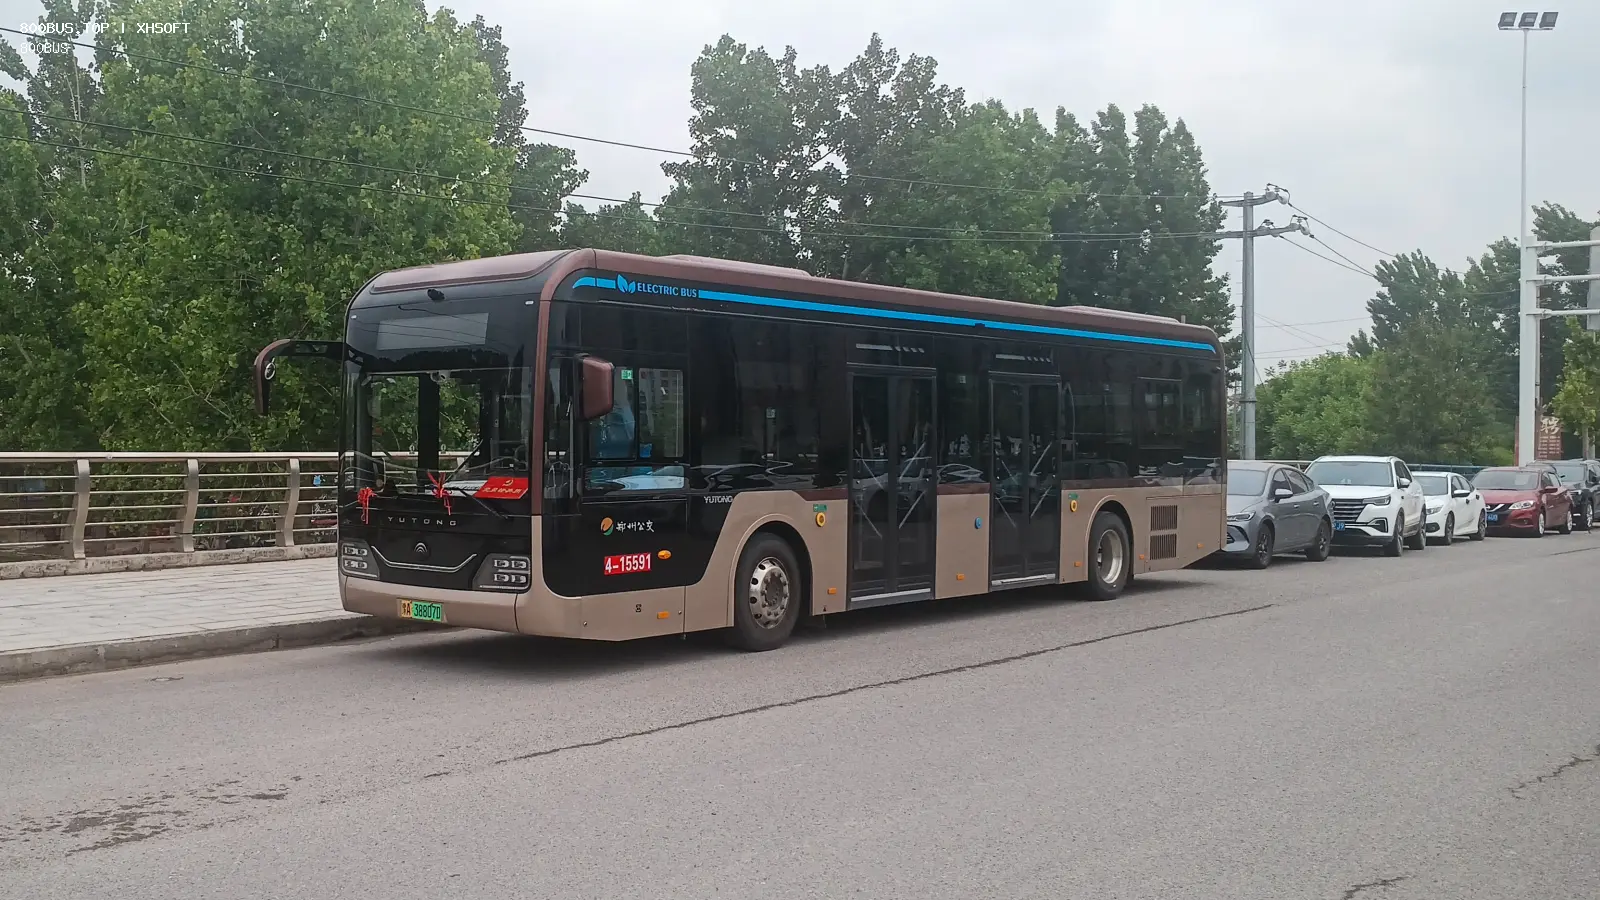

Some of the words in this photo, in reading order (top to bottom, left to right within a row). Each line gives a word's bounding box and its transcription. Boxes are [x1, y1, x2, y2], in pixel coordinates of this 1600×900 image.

[637, 282, 679, 296] ELECTRIC
[680, 287, 697, 298] BUS
[703, 495, 734, 504] YUTONG
[387, 516, 457, 526] YUTONG
[615, 519, 655, 533] 郑州公交
[604, 553, 652, 574] 4-15591
